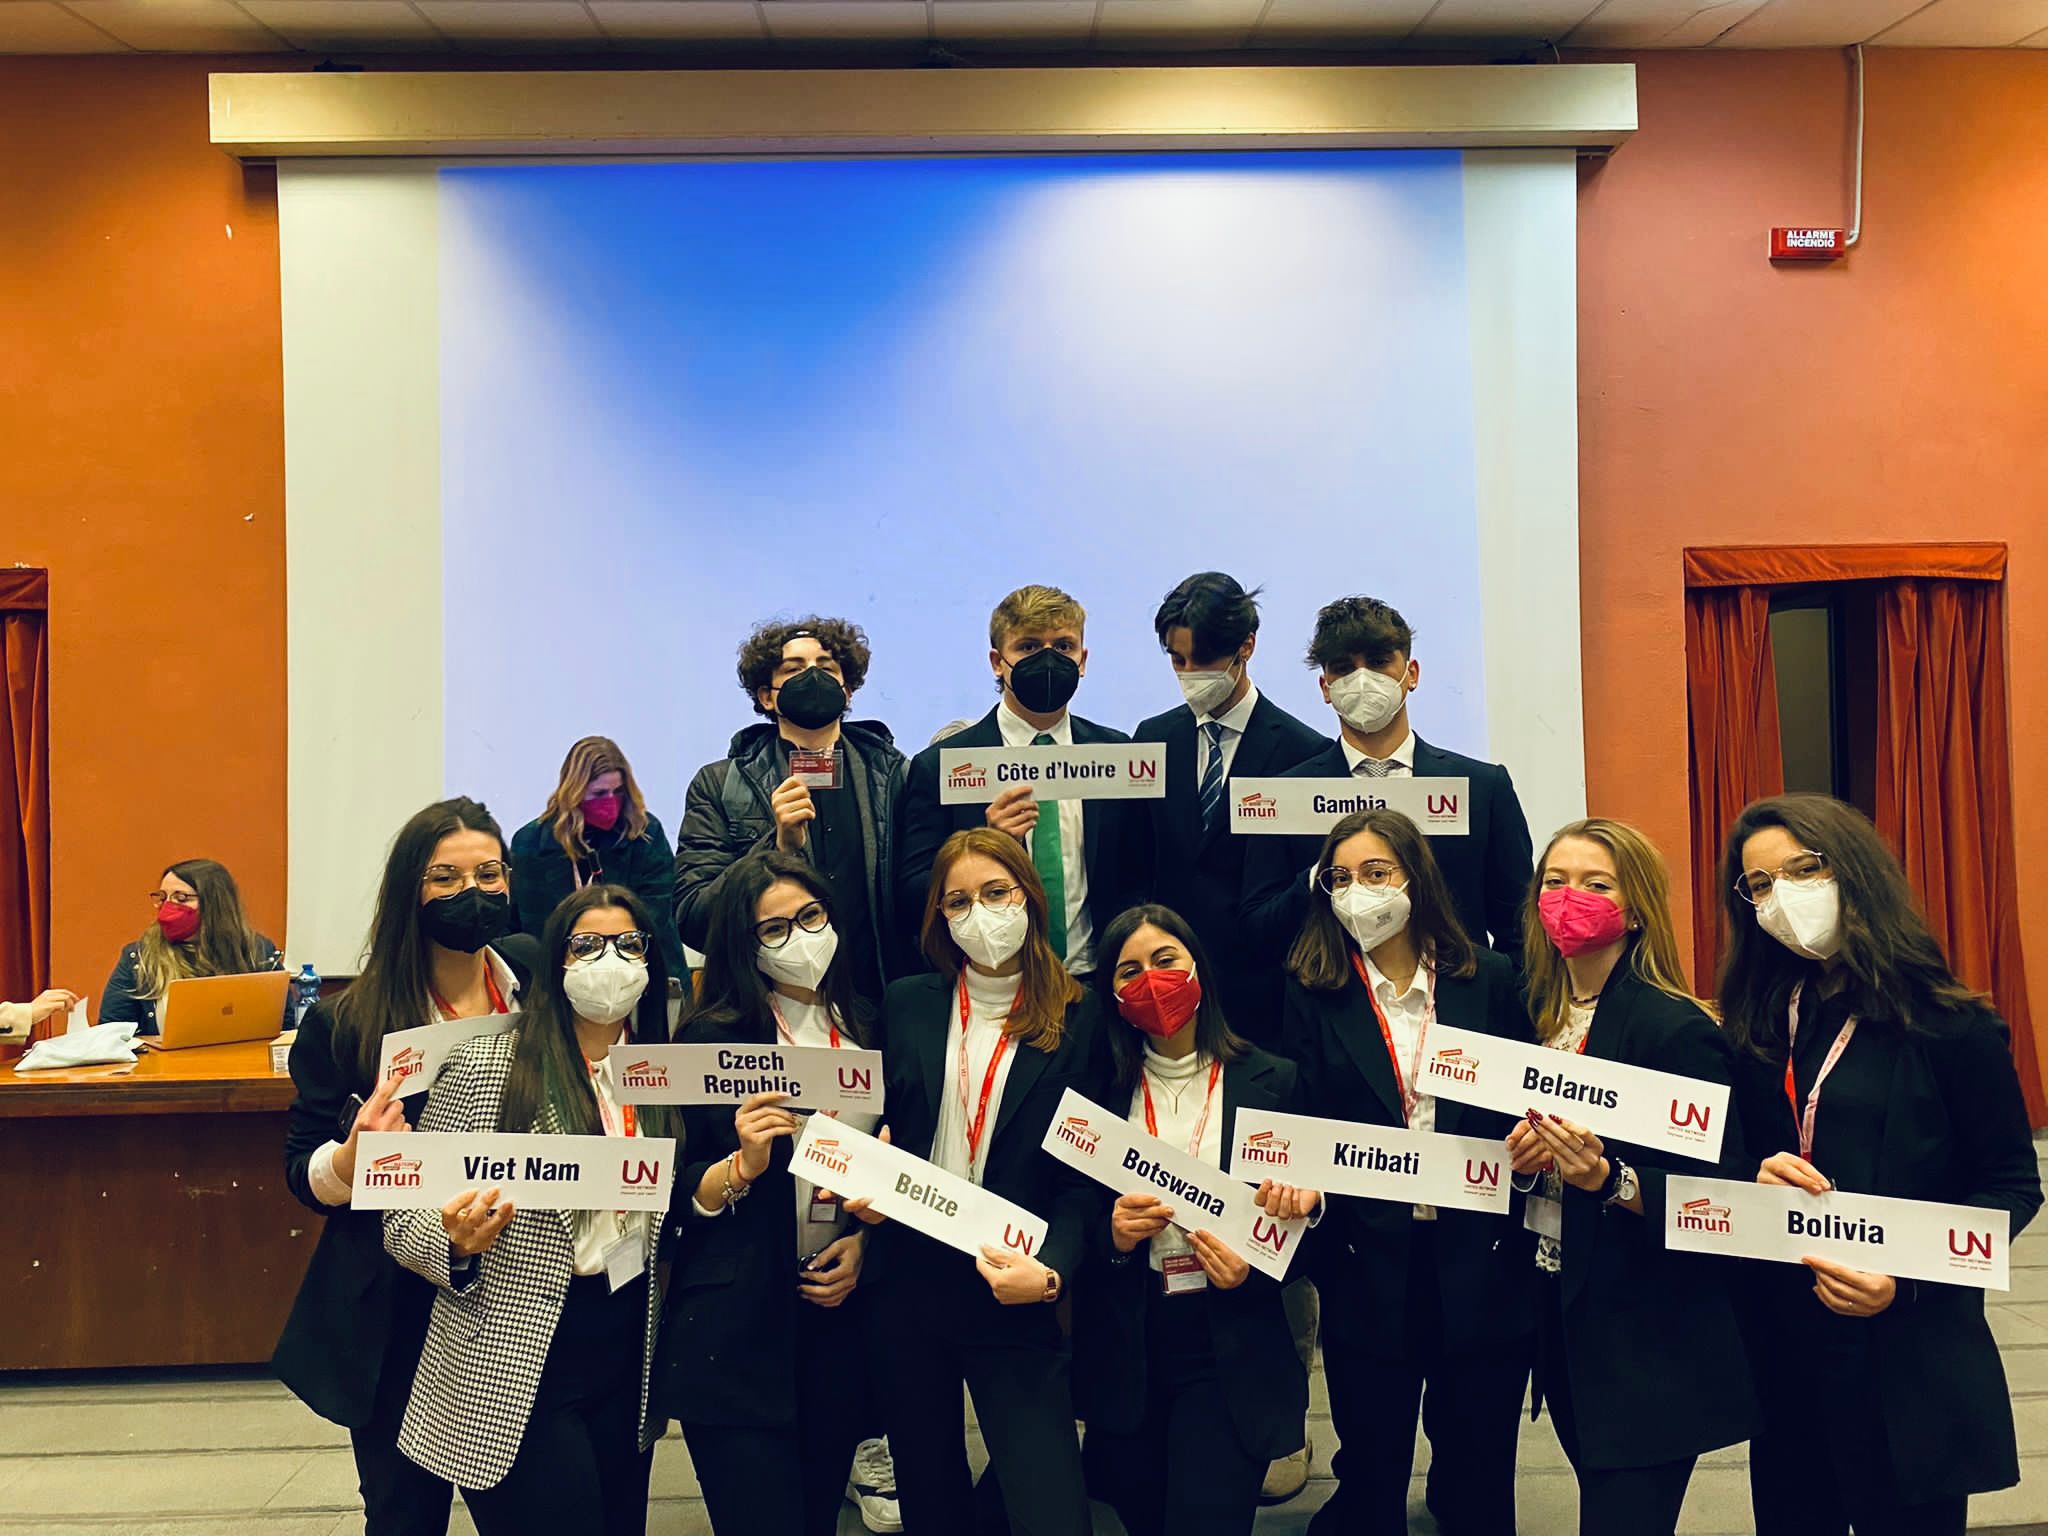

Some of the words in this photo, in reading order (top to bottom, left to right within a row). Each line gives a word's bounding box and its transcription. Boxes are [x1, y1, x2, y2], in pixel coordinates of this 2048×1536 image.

[1787, 230, 1835, 239] ALLARME
[1787, 239, 1835, 247] INCENDIO
[997, 763, 1039, 782] Côte
[1046, 761, 1116, 779] d'Ivoire
[1128, 760, 1156, 778] UN
[948, 776, 986, 788] imun
[1238, 805, 1276, 817] imun
[1313, 795, 1386, 813] Gambia
[1427, 794, 1457, 814] UN
[719, 1050, 784, 1071] Czech
[1429, 1058, 1477, 1083] imun
[623, 1073, 668, 1087] imun
[704, 1074, 801, 1097] Republic
[838, 1067, 871, 1090] UN
[1523, 1066, 1619, 1108] Belarus
[1670, 1098, 1710, 1131] UN
[1057, 1121, 1096, 1156] imun
[804, 1144, 848, 1174] imun
[1242, 1143, 1288, 1165] imun
[1333, 1142, 1419, 1175] Kiribati
[365, 1169, 420, 1187] imun
[464, 1157, 516, 1181] Viet
[524, 1157, 580, 1181] Nam
[622, 1159, 659, 1184] UN
[1465, 1159, 1499, 1186] UN
[1122, 1148, 1225, 1217] Botswana
[895, 1172, 958, 1217] Belize
[1253, 1215, 1288, 1252] UN
[1677, 1211, 1730, 1233] imun
[1788, 1210, 1884, 1245] Bolivia
[1003, 1223, 1034, 1256] UN
[1948, 1228, 1992, 1259] UN
